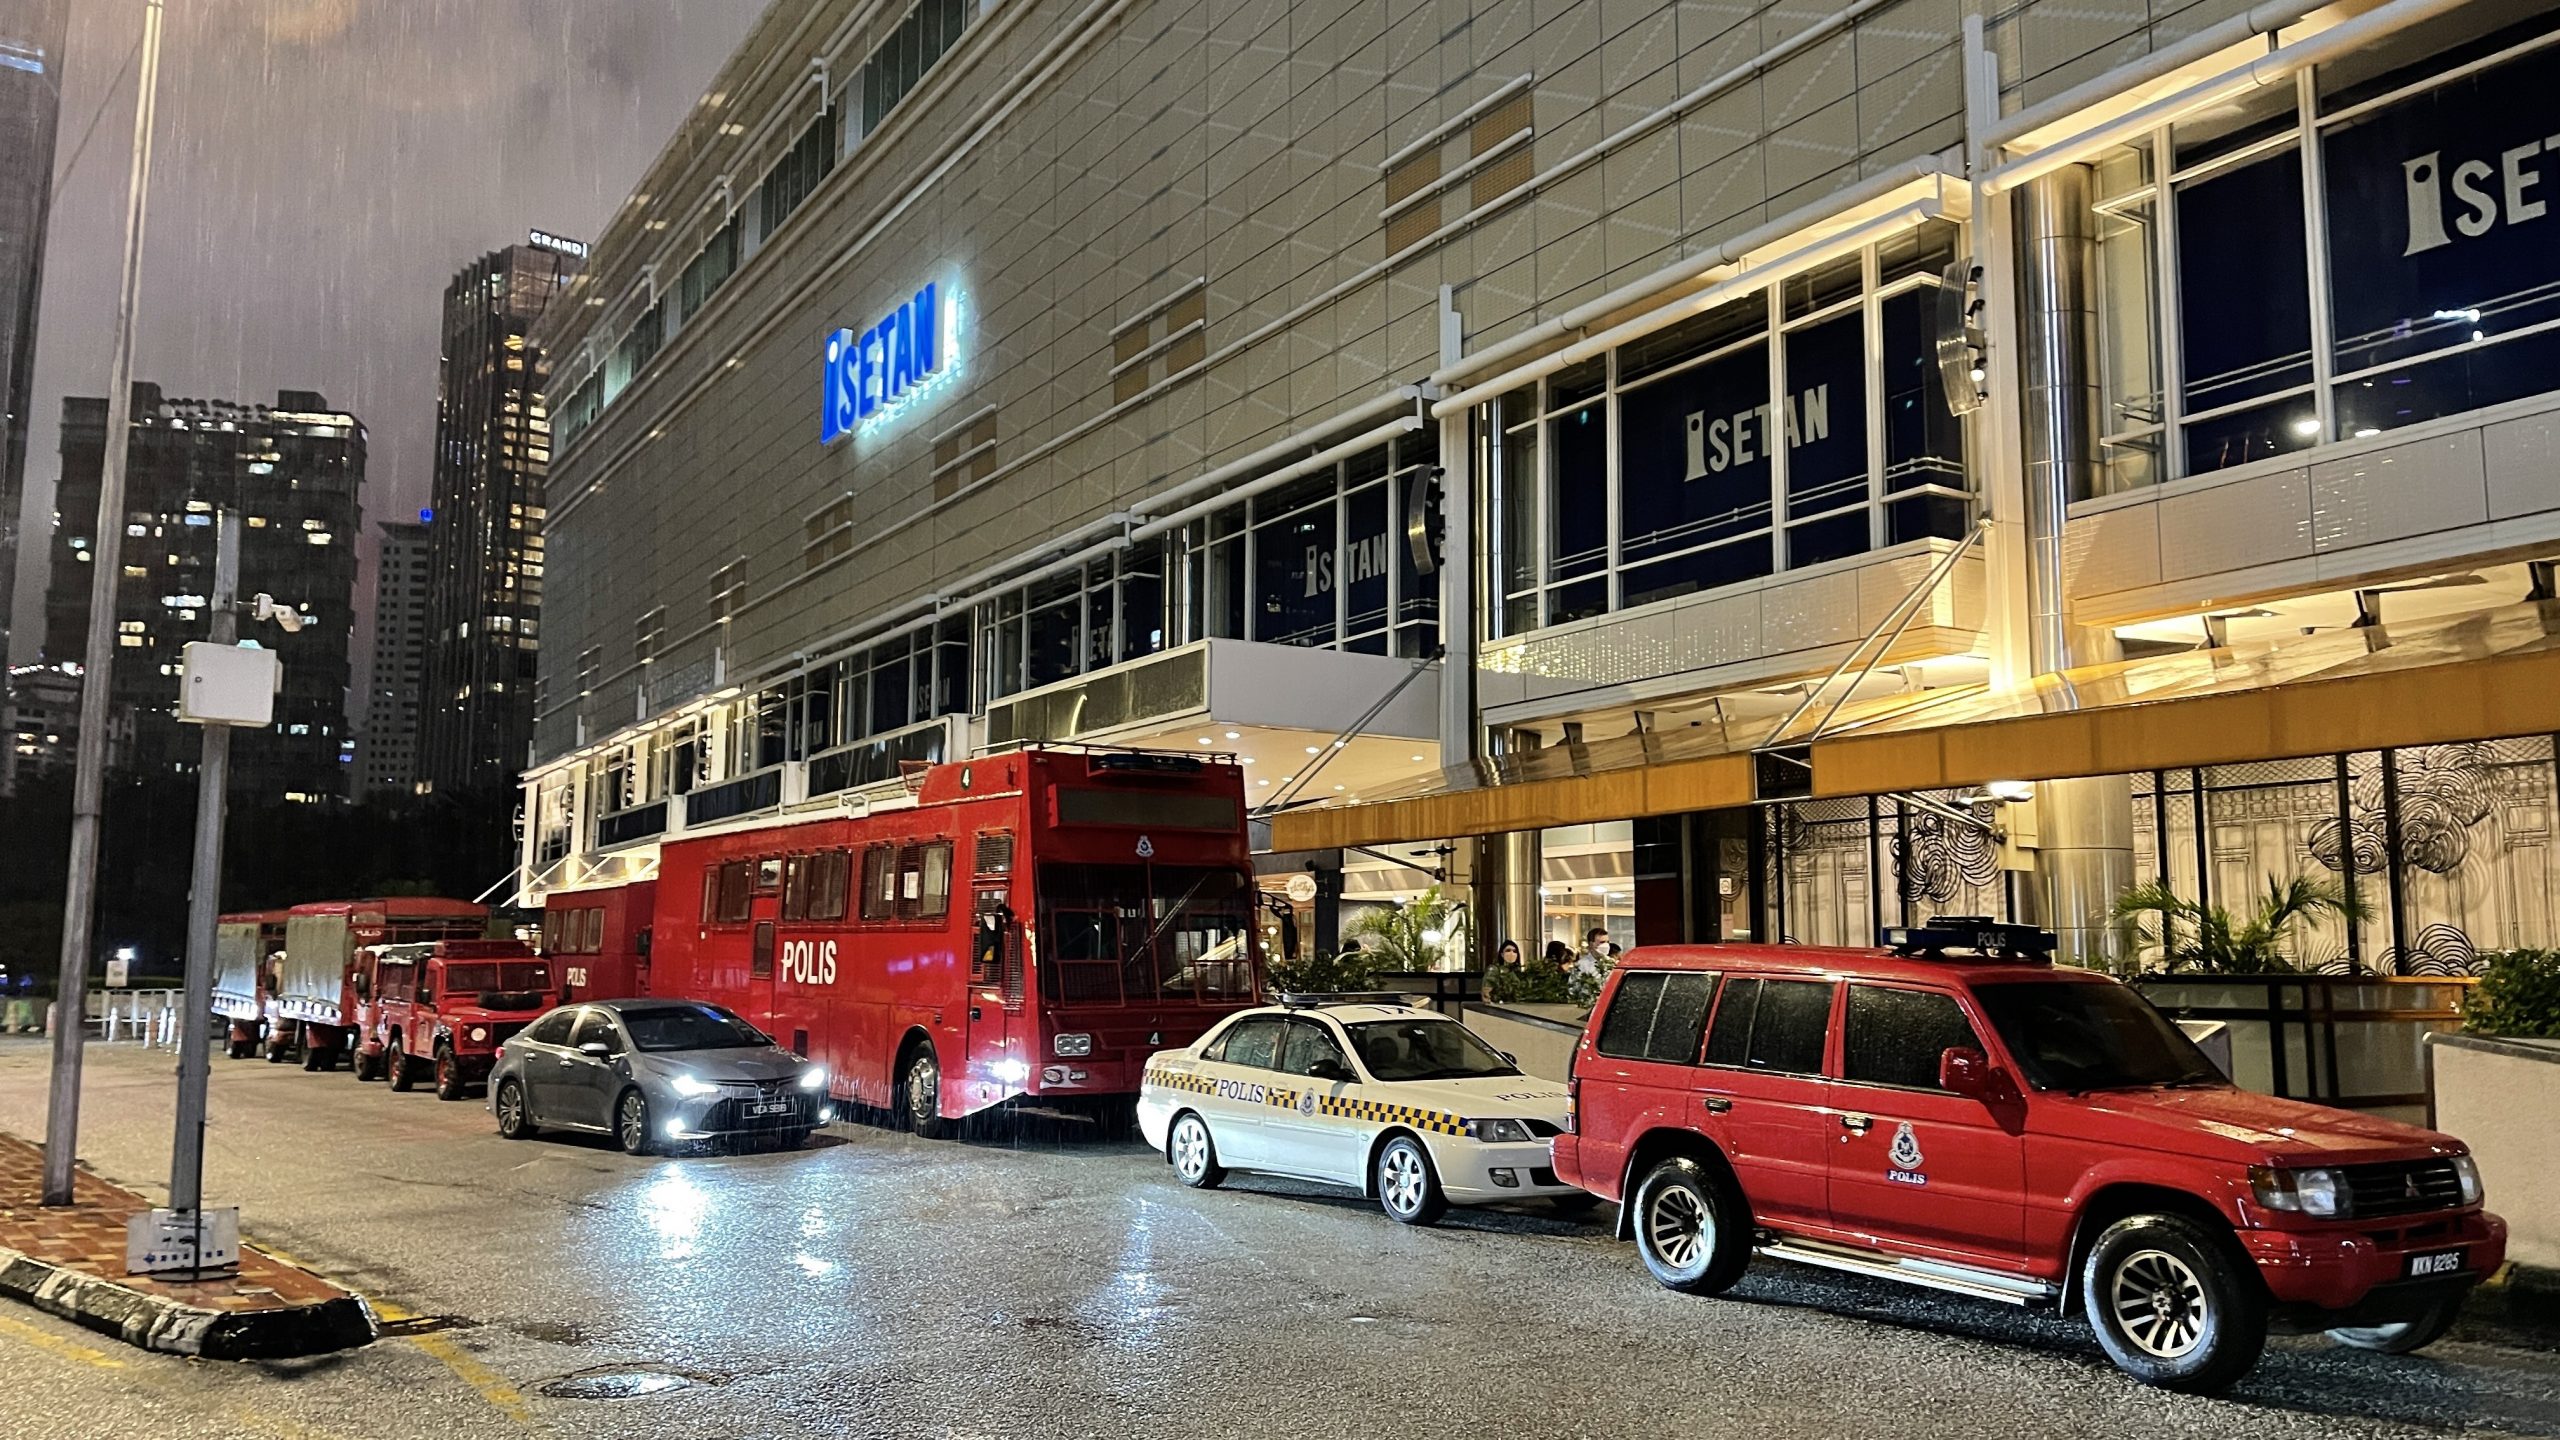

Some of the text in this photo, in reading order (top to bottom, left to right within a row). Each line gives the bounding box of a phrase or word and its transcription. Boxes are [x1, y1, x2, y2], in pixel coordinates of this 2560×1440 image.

[530, 232, 582, 255] GRAND
[1304, 533, 1387, 598] ISTAN
[962, 768, 970, 787] 4
[1977, 932, 2006, 947] POLIS
[781, 939, 837, 985] POLIS
[1150, 1032, 1160, 1045] 4
[1218, 1079, 1265, 1104] POLIS
[1888, 1170, 1926, 1185] POLIS
